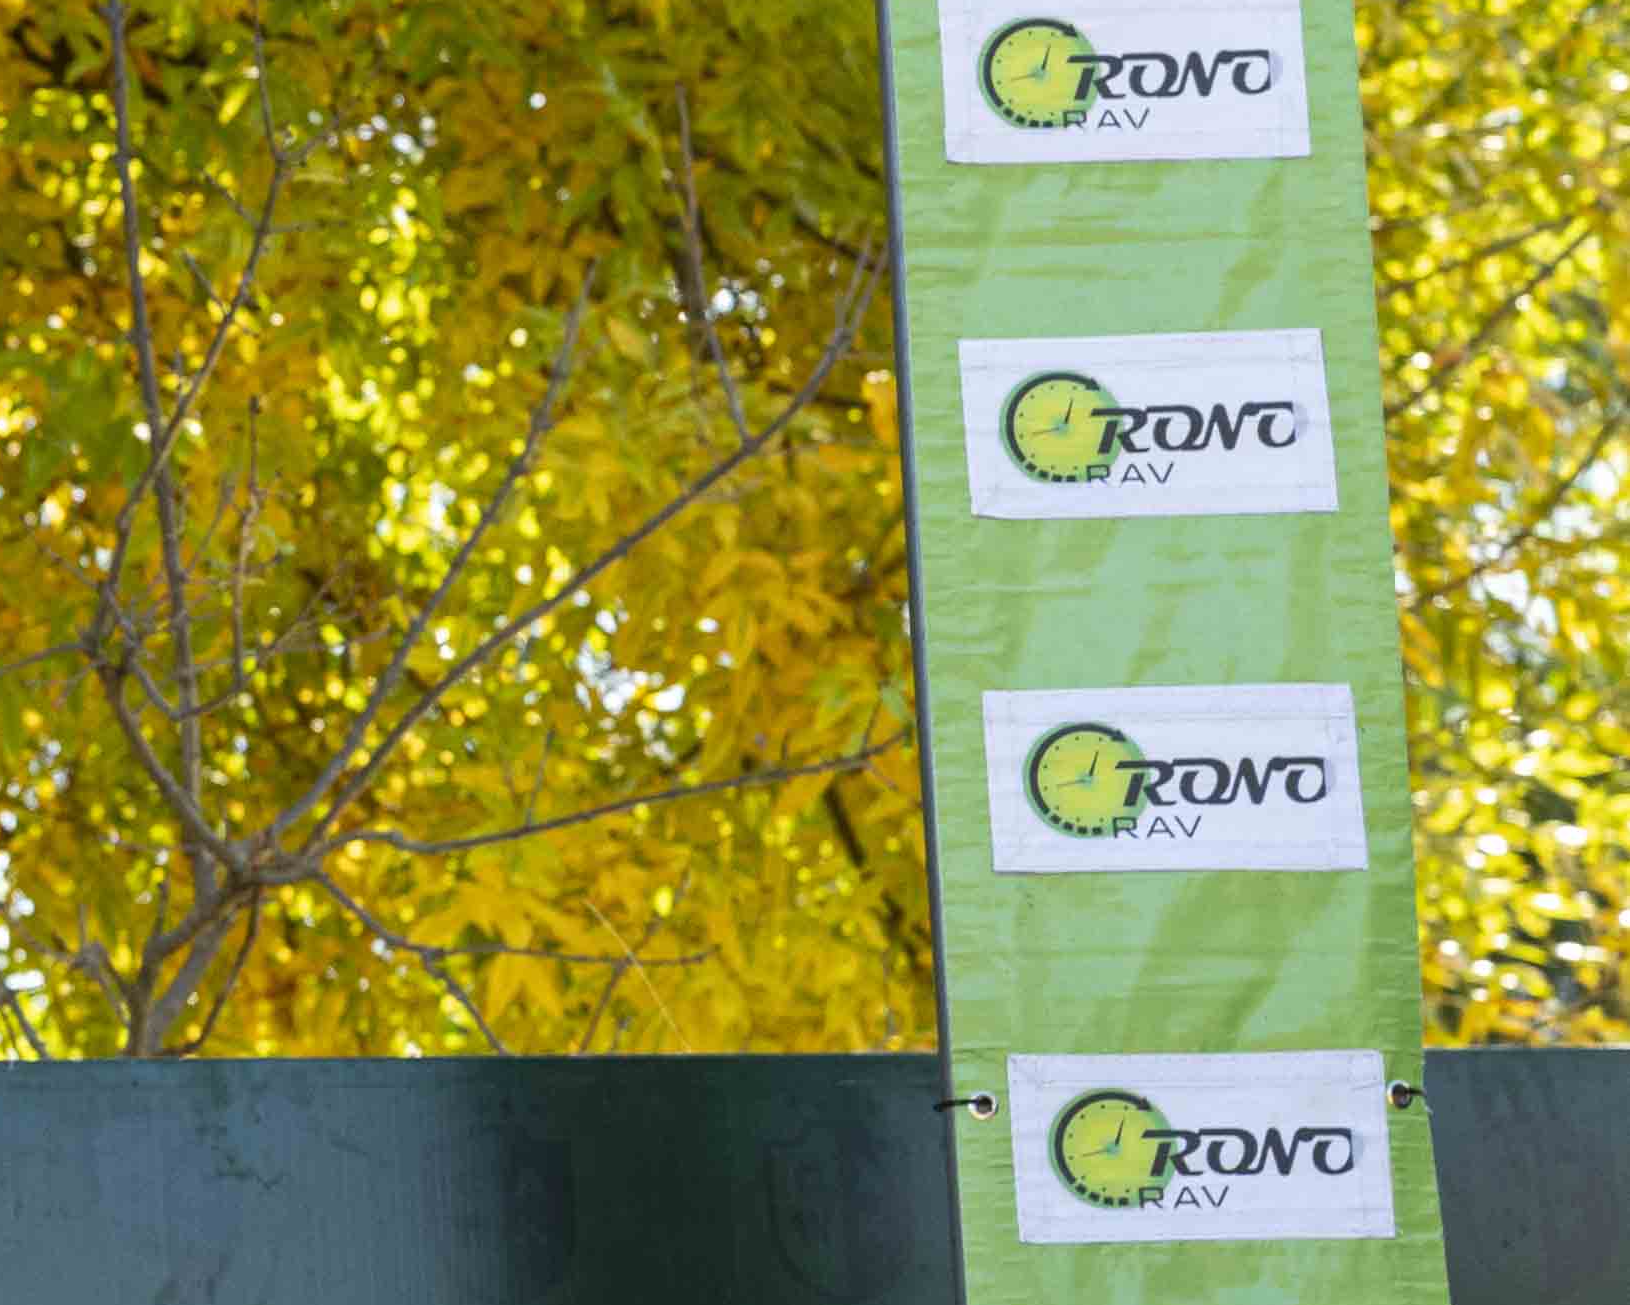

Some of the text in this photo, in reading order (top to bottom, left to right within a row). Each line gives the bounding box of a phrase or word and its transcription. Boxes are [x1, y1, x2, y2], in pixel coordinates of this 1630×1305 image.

[1062, 107, 1150, 129] RAV
[1086, 461, 1175, 484] RAV
[1112, 815, 1203, 839] RAV
[1139, 1185, 1230, 1209] RAV
